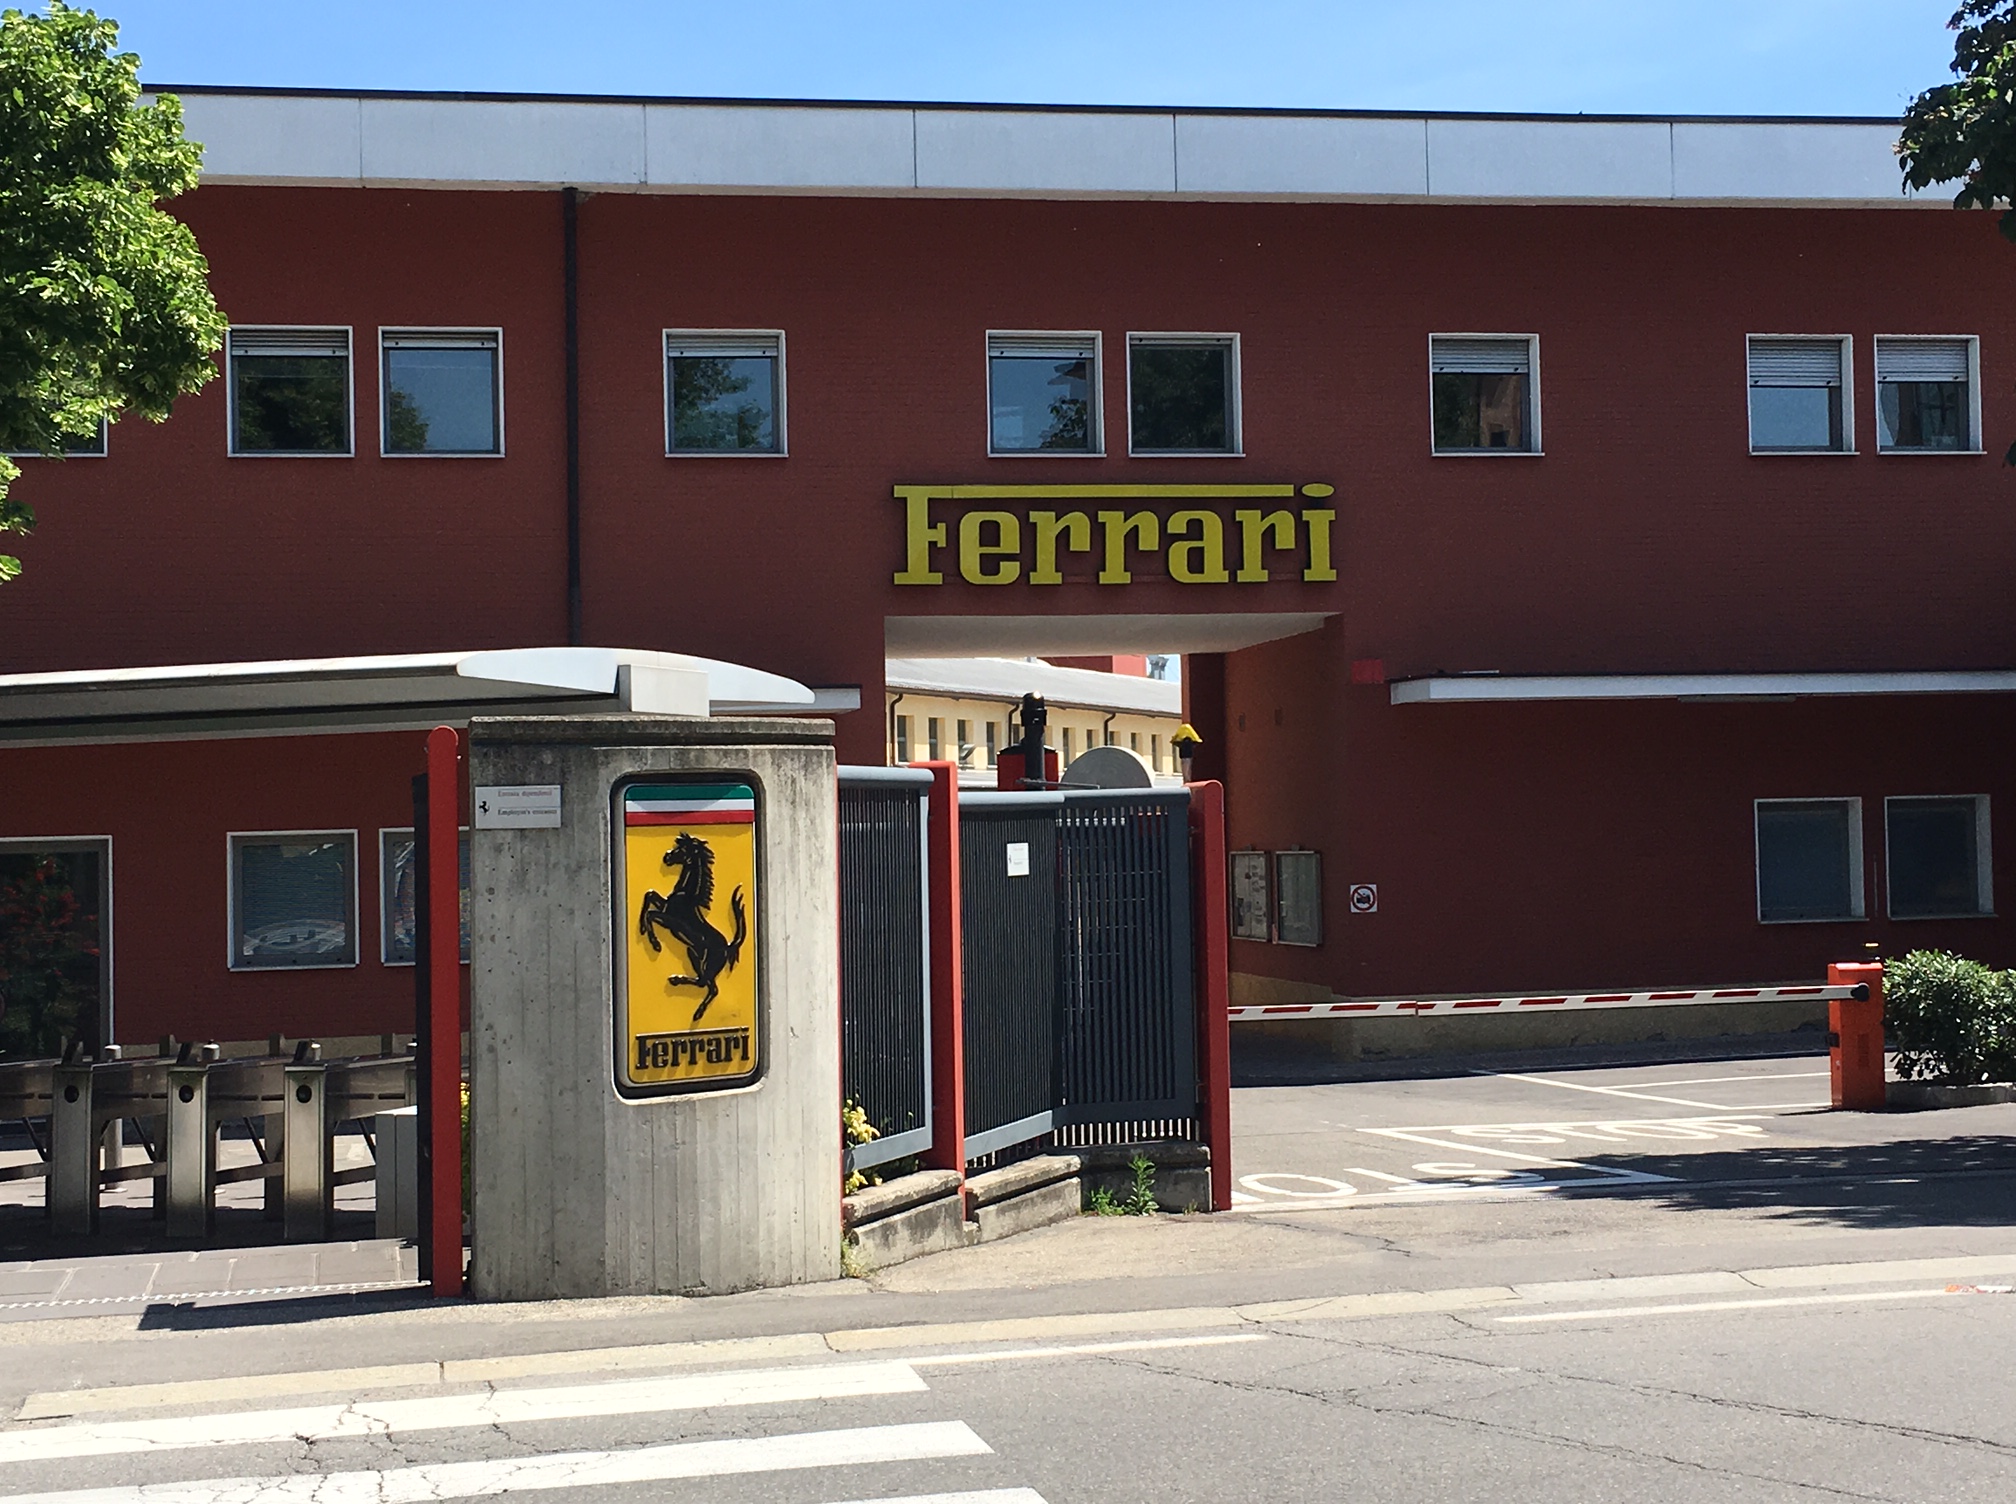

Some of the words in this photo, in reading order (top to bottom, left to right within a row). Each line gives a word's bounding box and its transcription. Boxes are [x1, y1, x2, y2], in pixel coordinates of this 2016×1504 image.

[893, 483, 1337, 585] Ferrari
[635, 1026, 750, 1070] Ferrari
[1450, 1121, 1770, 1144] STOP
[1231, 1162, 1545, 1201] STO
